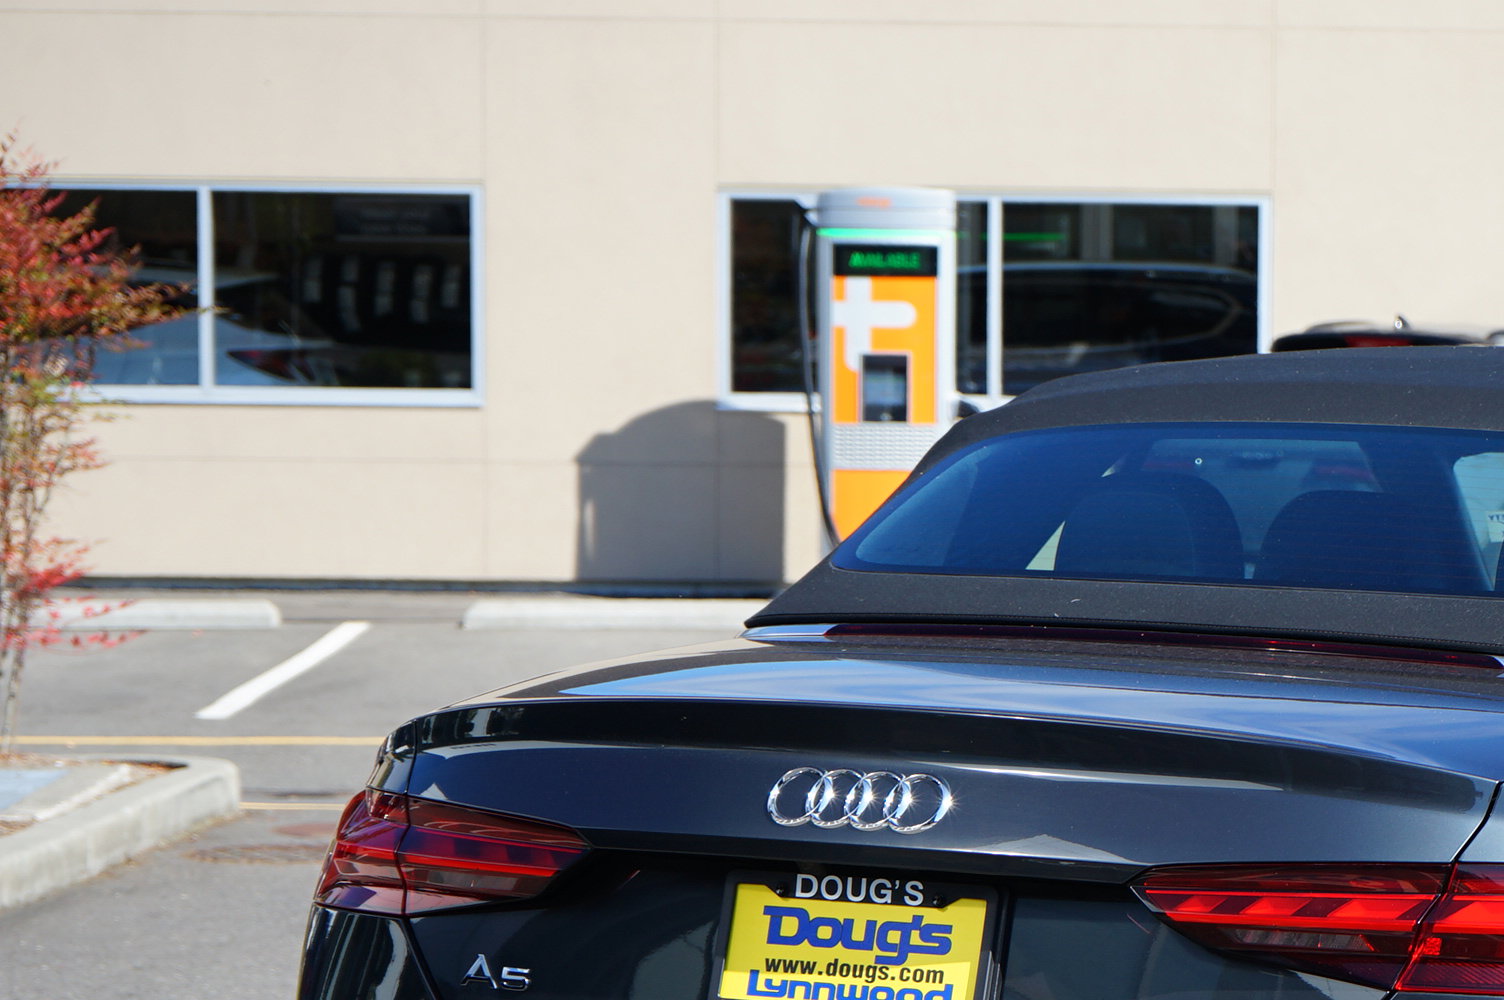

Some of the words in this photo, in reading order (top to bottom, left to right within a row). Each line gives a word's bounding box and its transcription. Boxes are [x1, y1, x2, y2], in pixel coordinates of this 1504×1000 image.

[795, 874, 924, 906] DOUG'S
[460, 953, 531, 991] A5
[765, 958, 944, 984] www.dougs.com
